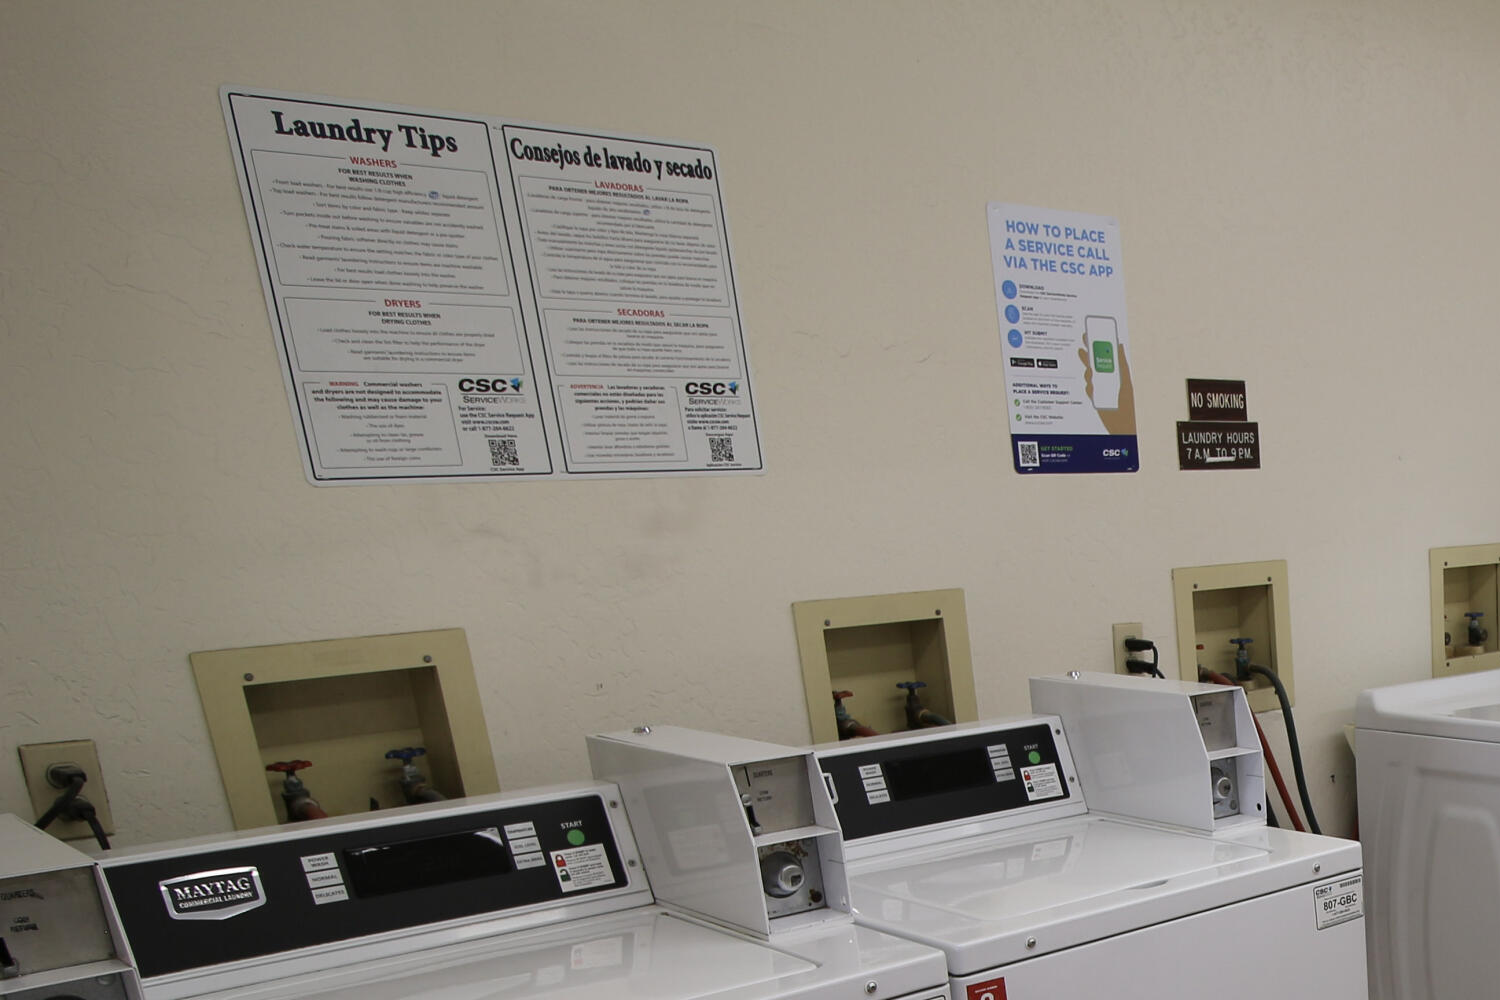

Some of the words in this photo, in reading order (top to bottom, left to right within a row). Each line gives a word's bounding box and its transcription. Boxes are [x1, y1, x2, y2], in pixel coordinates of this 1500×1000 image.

[271, 110, 392, 152] Laundry
[398, 124, 458, 158] Tips
[350, 156, 399, 170] WASHERS
[510, 138, 581, 170] Consejos
[583, 146, 602, 164] de
[603, 147, 652, 174] lavado
[653, 160, 663, 181] y
[666, 158, 713, 181] secado
[594, 180, 645, 193] LAVADORAS
[1006, 219, 1039, 236] HOW
[1042, 224, 1061, 238] TO
[1065, 227, 1105, 244] PLACE
[1005, 238, 1015, 251] A
[1018, 239, 1074, 257] SERVICE
[1077, 246, 1110, 261] CALL
[1003, 255, 1028, 270] VIA
[1030, 258, 1057, 273] THE
[1060, 261, 1085, 275] CSC
[1089, 264, 1114, 278] APP
[384, 298, 422, 309] DRYERS
[617, 308, 665, 319] SECADORAS
[458, 378, 508, 393] CSC
[685, 382, 726, 395] CSC
[1190, 392, 1204, 408] NO
[1206, 392, 1245, 409] SMOKING
[1182, 432, 1223, 444] LAUNDRY
[1226, 432, 1255, 444] HOURS
[1102, 449, 1120, 457] CSC
[1186, 447, 1192, 460] 7
[1215, 447, 1227, 459] TO
[1231, 447, 1237, 459] 9
[560, 820, 582, 830] START
[173, 877, 251, 901] MAYTAG
[179, 896, 223, 909] COMMERCIAL
[223, 891, 253, 903] LAUNDRY
[1323, 893, 1358, 911] 807-GBC
